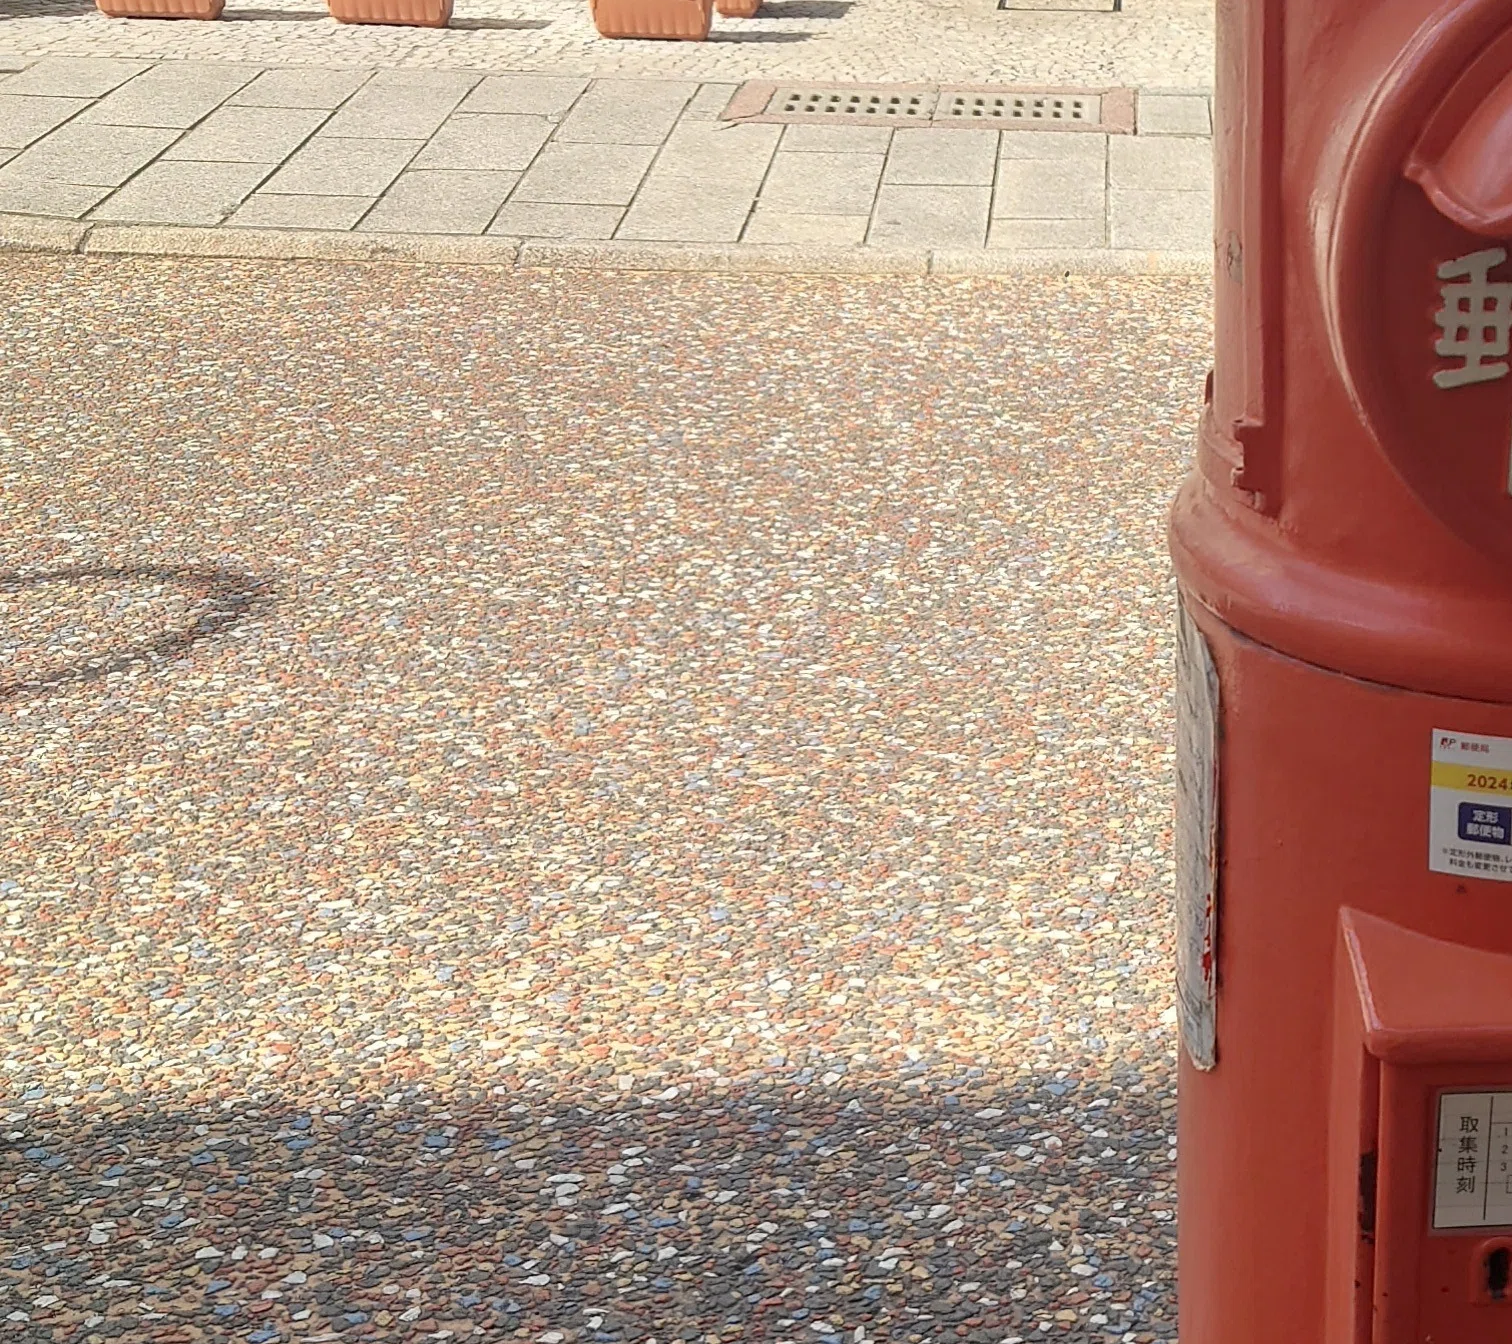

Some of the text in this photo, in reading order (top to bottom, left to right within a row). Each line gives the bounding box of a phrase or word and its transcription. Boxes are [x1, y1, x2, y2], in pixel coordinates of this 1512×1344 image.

[1472, 809, 1500, 823] 定形
[1466, 824, 1505, 840] 郵便物
[1456, 1115, 1480, 1194] 取集時刻
[1502, 1144, 1509, 1154] 2
[1500, 1162, 1507, 1172] 3
